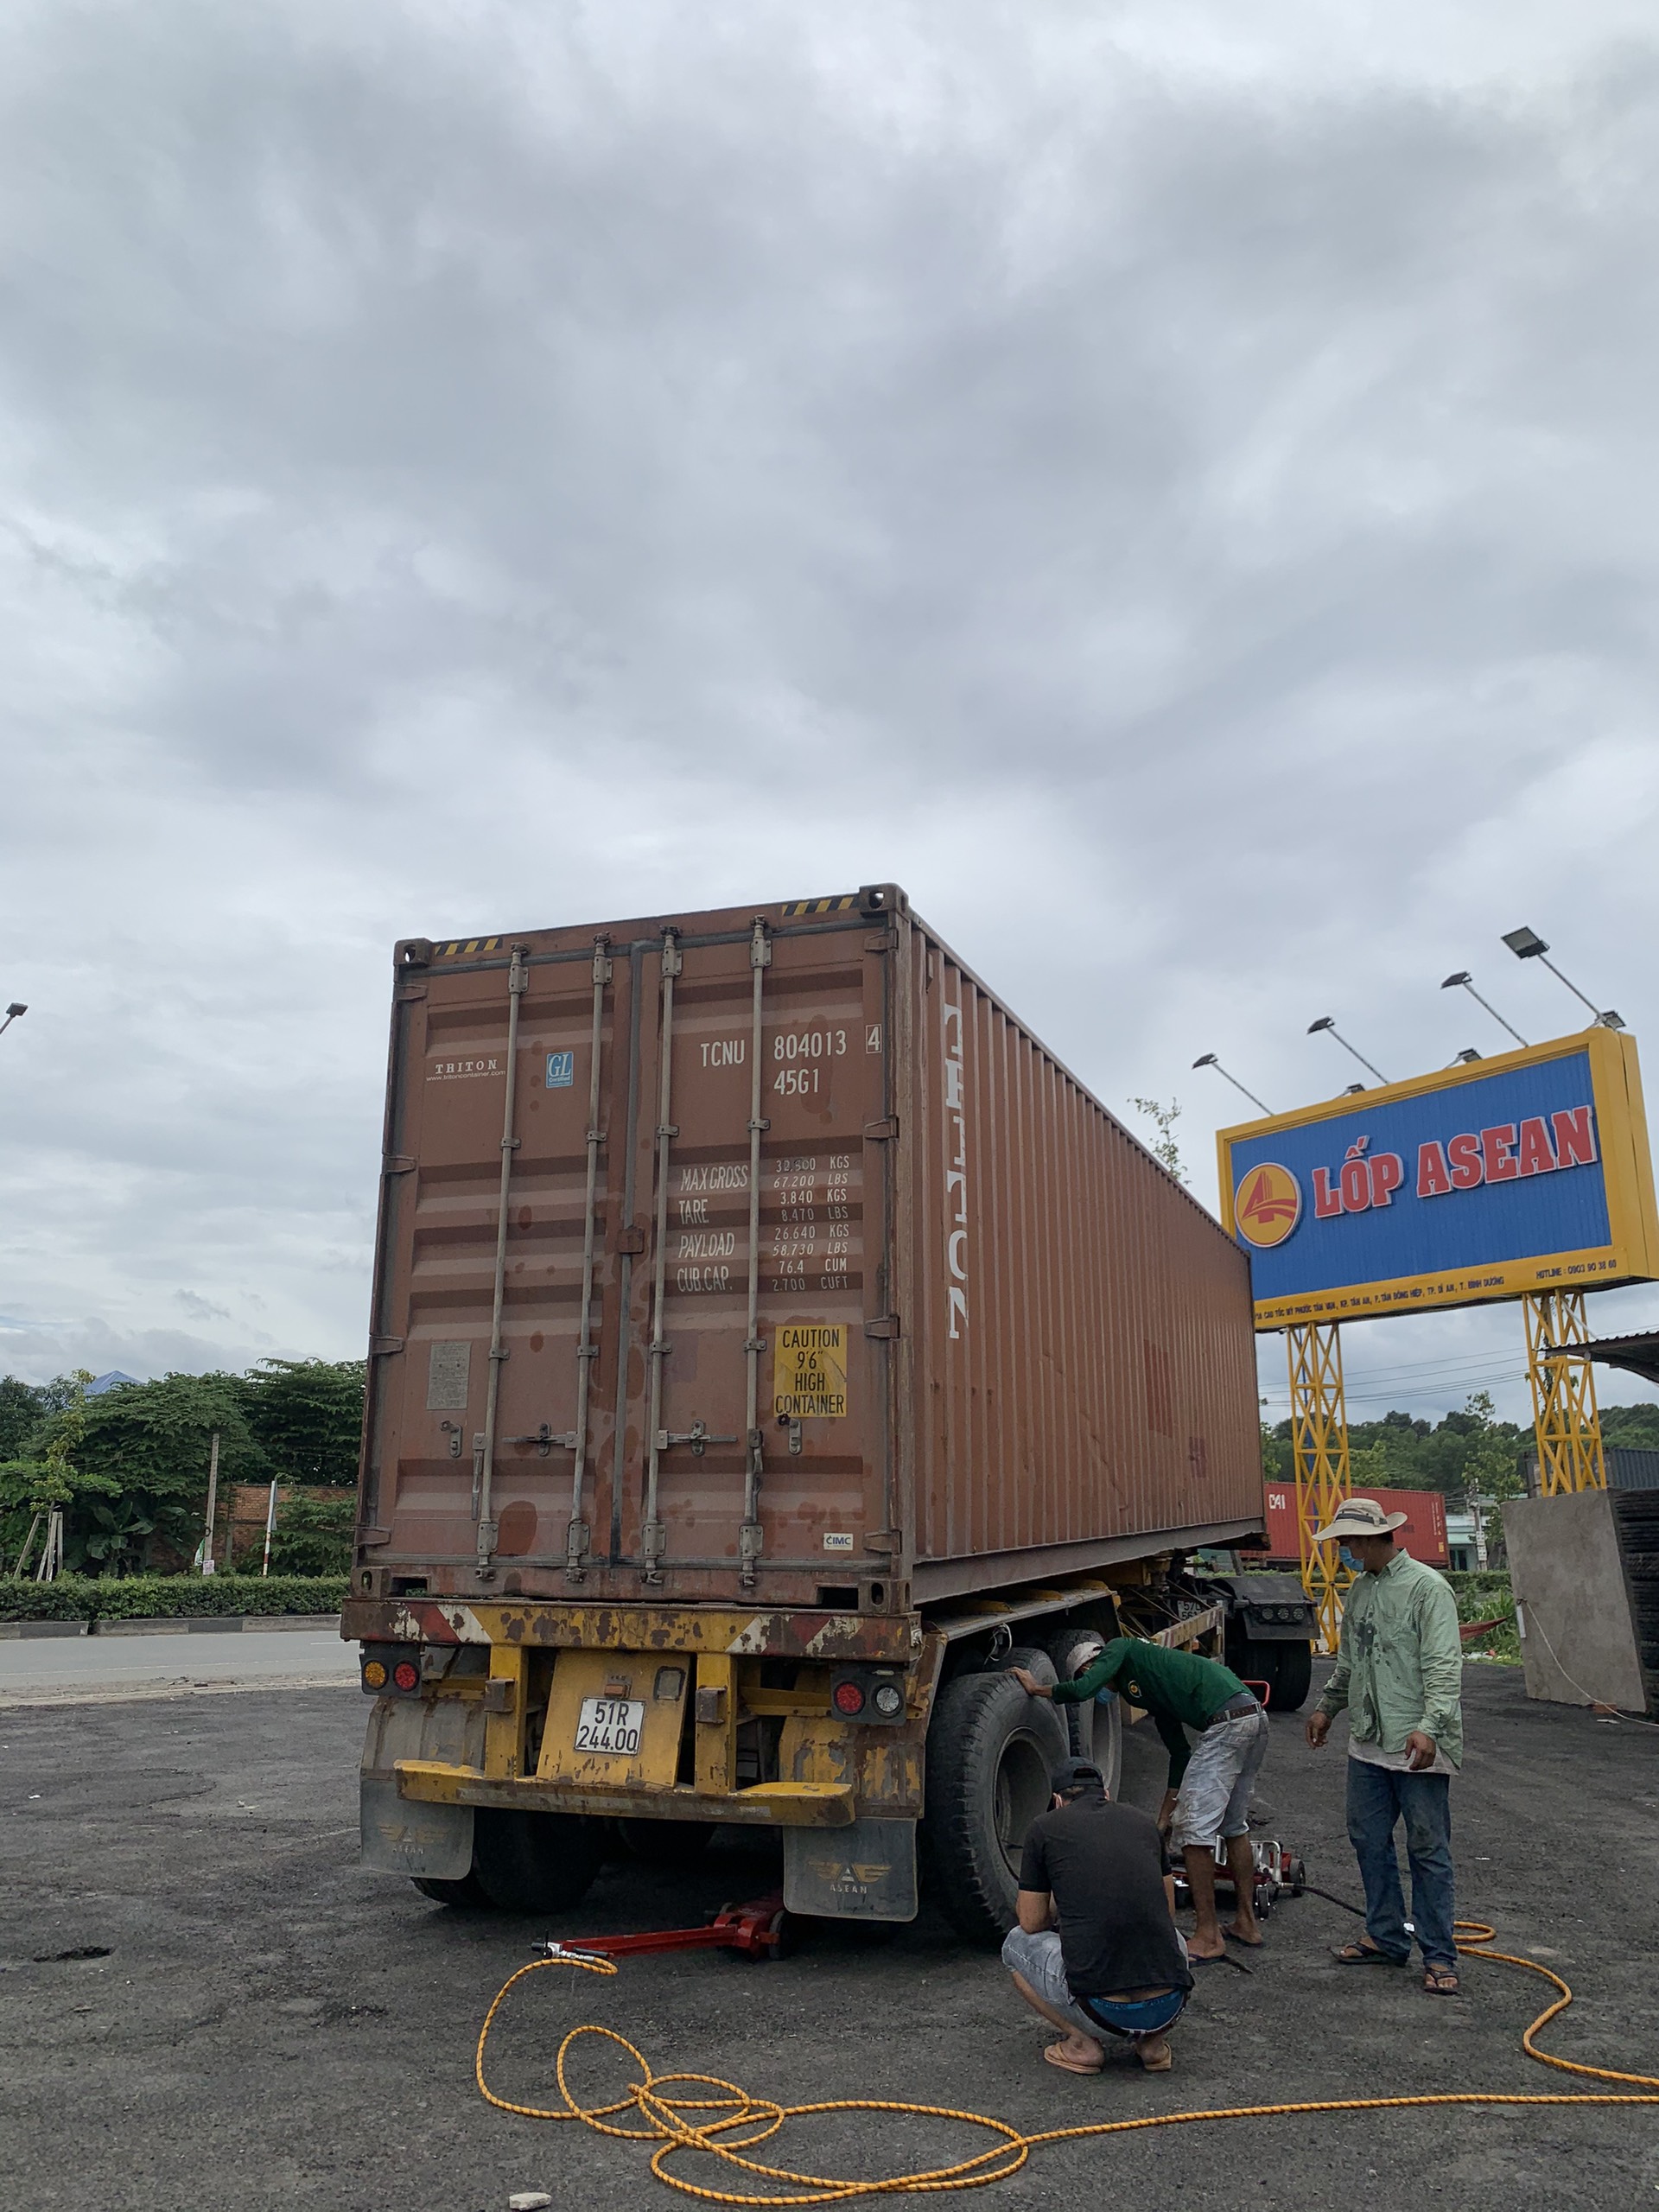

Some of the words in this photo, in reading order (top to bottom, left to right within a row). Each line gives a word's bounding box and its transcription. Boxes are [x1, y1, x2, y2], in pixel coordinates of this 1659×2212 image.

[700, 1039, 745, 1067] TCNU
[773, 1030, 847, 1060] 804013
[868, 1027, 880, 1051] 4
[435, 1058, 498, 1074] TRITON
[548, 1053, 571, 1077] GL
[426, 1070, 505, 1082] www.tritoncontainer.com
[773, 1068, 819, 1095] 45G1
[830, 1155, 849, 1170] KGS
[1312, 1135, 1404, 1218] LỐP
[1416, 1104, 1599, 1198] ASEAN
[680, 1168, 708, 1191] MAX
[709, 1165, 748, 1190] GROSS
[773, 1175, 815, 1189] 67.200
[828, 1173, 849, 1185] LBS
[780, 1190, 813, 1205] 3.840
[827, 1188, 847, 1203] KGS
[678, 1199, 709, 1225] TARE
[781, 1208, 815, 1223] 8.470
[828, 1206, 849, 1220] LBS
[774, 1225, 816, 1241] 26.640
[830, 1224, 849, 1238] KGS
[678, 1232, 734, 1259] PAYLOAD
[772, 1243, 814, 1257] 58.730
[827, 1242, 849, 1255] LBS
[779, 1259, 804, 1274] 76.4
[824, 1257, 847, 1273] CUM
[772, 1278, 805, 1292] 2.700
[820, 1276, 848, 1289] CUFT
[782, 1329, 840, 1348] CAUTION
[795, 1373, 825, 1391] HIGH
[775, 1395, 844, 1414] CONTAINER
[1268, 1493, 1286, 1510] CAI
[826, 1535, 851, 1545] CIMC
[594, 1701, 629, 1726] 51R
[575, 1725, 639, 1751] 244.00
[830, 1884, 868, 1895] ASEAN
